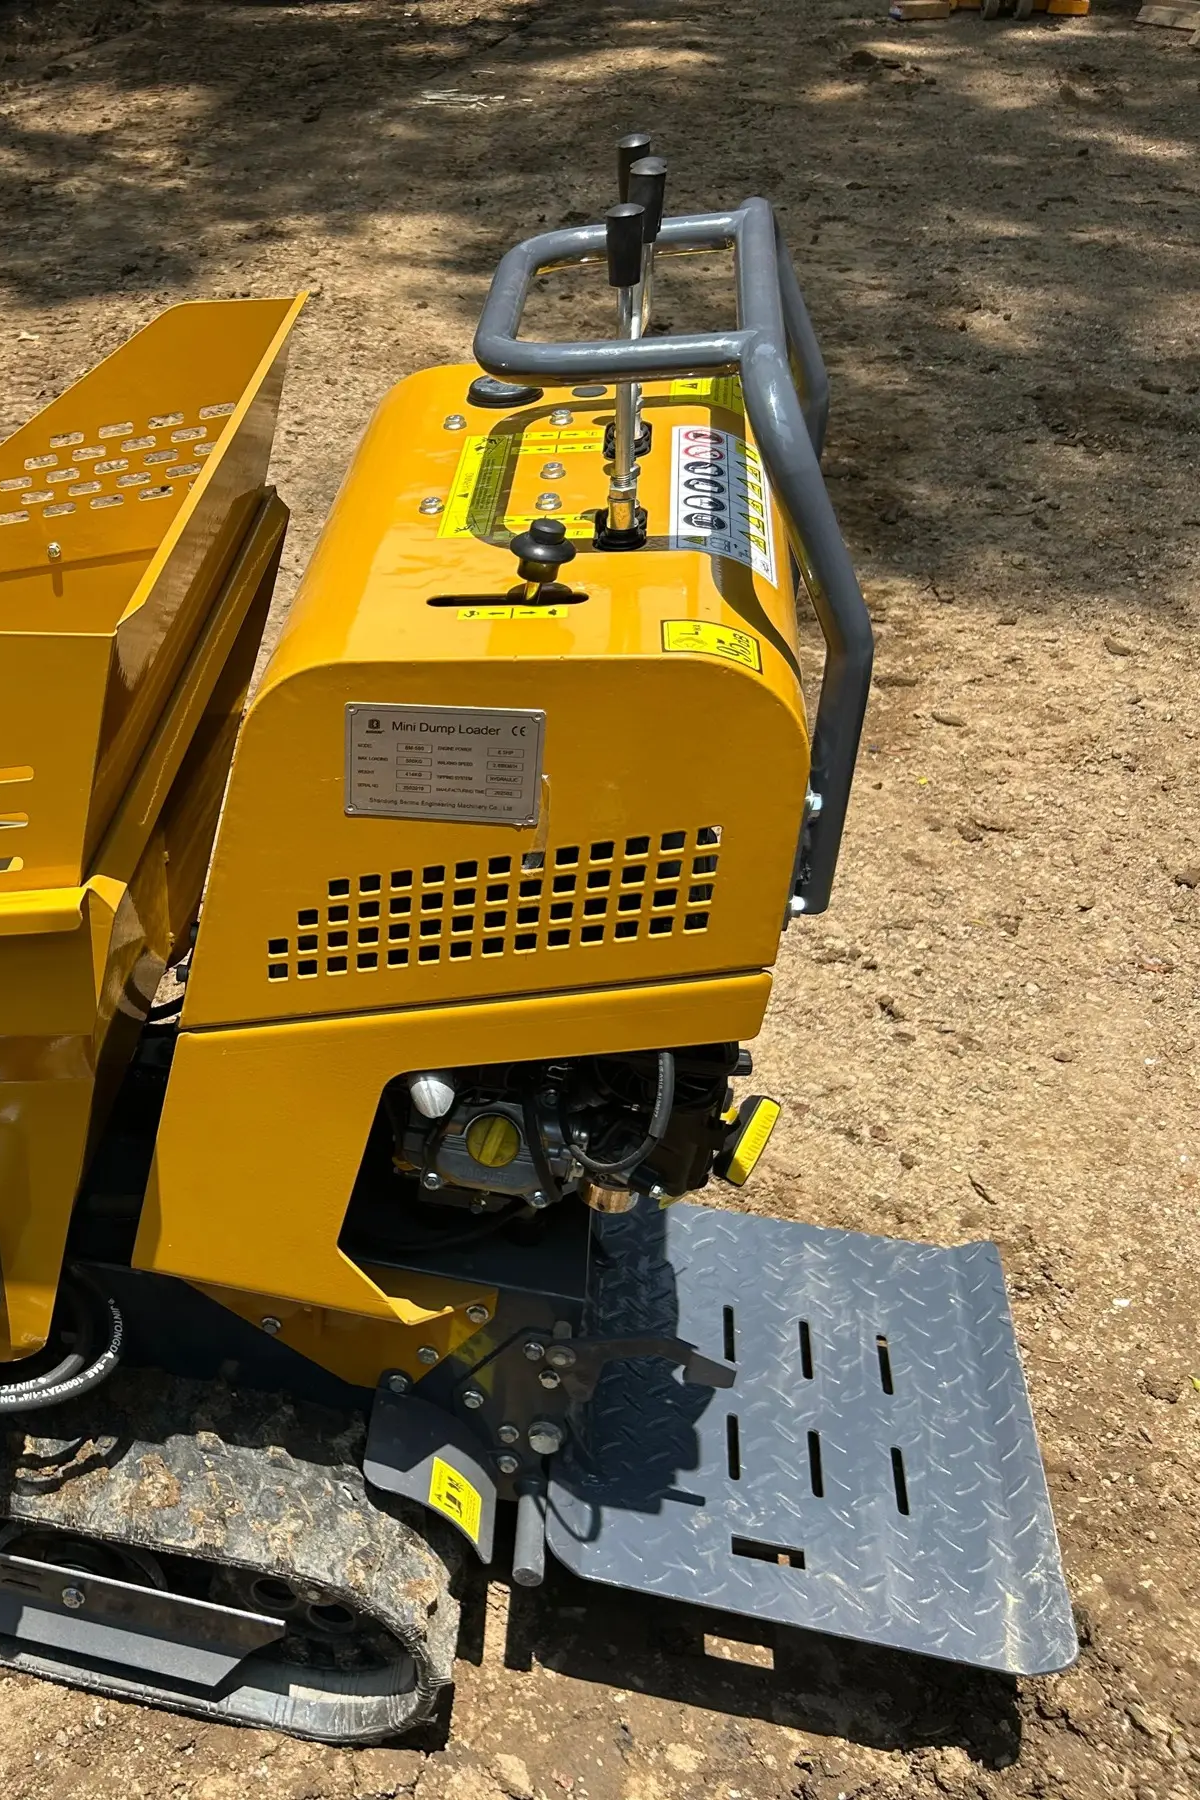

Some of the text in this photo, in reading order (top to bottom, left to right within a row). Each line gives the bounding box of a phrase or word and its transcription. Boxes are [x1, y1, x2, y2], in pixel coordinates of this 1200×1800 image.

[392, 721, 416, 732] Mini
[420, 722, 455, 736] Dump
[459, 724, 501, 736] Loader
[511, 725, 527, 737] CE
[369, 797, 398, 805] Shandong
[421, 800, 456, 808] Engineering
[457, 802, 487, 810] Machinery
